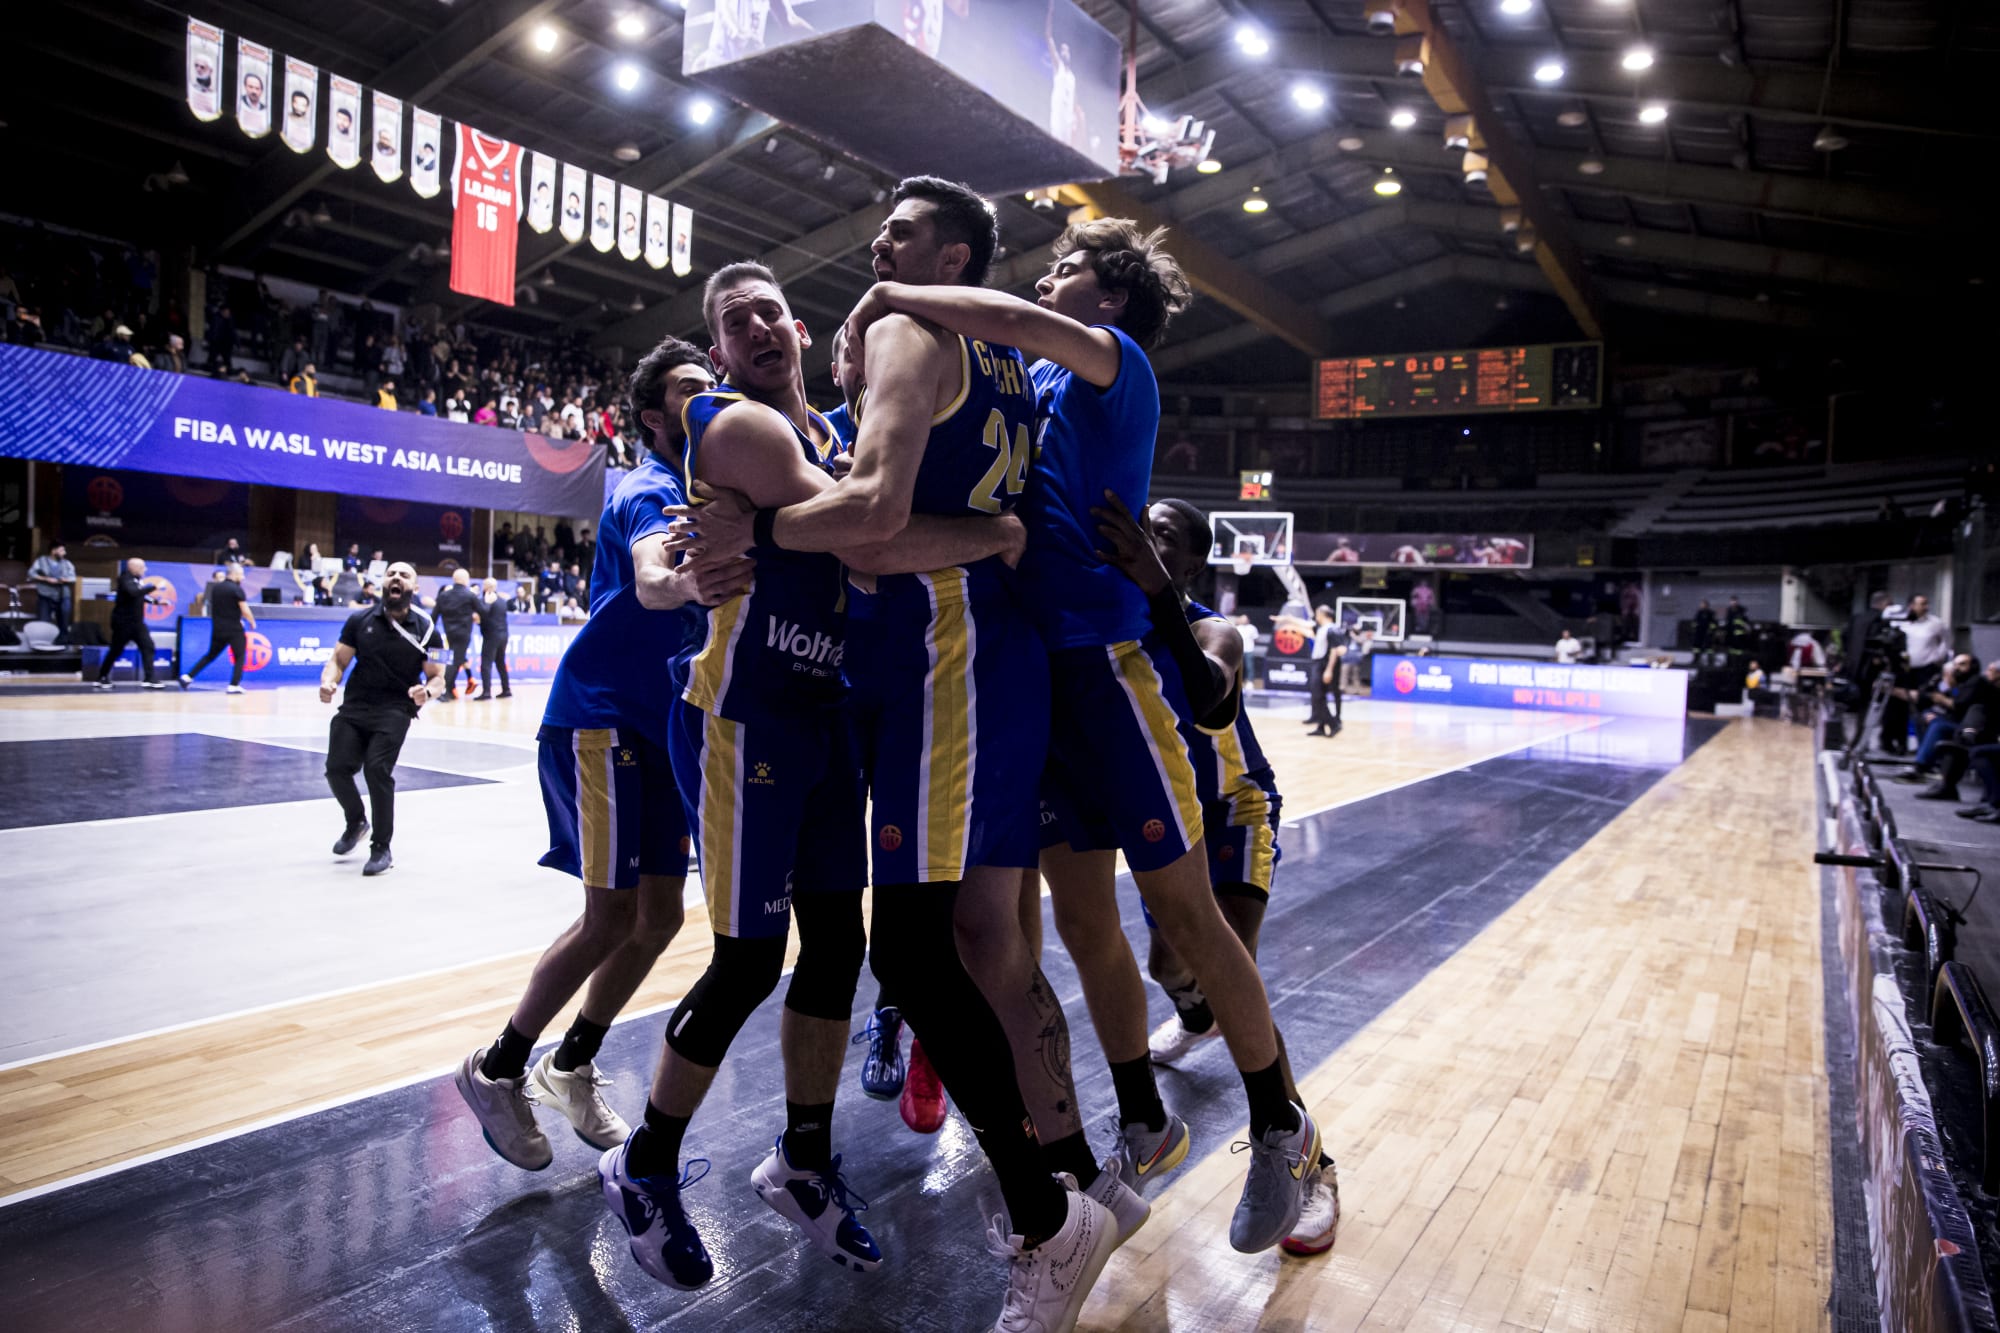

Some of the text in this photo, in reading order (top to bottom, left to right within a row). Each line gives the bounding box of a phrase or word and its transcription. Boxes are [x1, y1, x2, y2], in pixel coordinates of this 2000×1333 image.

[174, 417, 523, 484] FIBA WASL WEST ASIA LEAGUE
[968, 407, 1030, 515] 24
[748, 777, 775, 786] KELME
